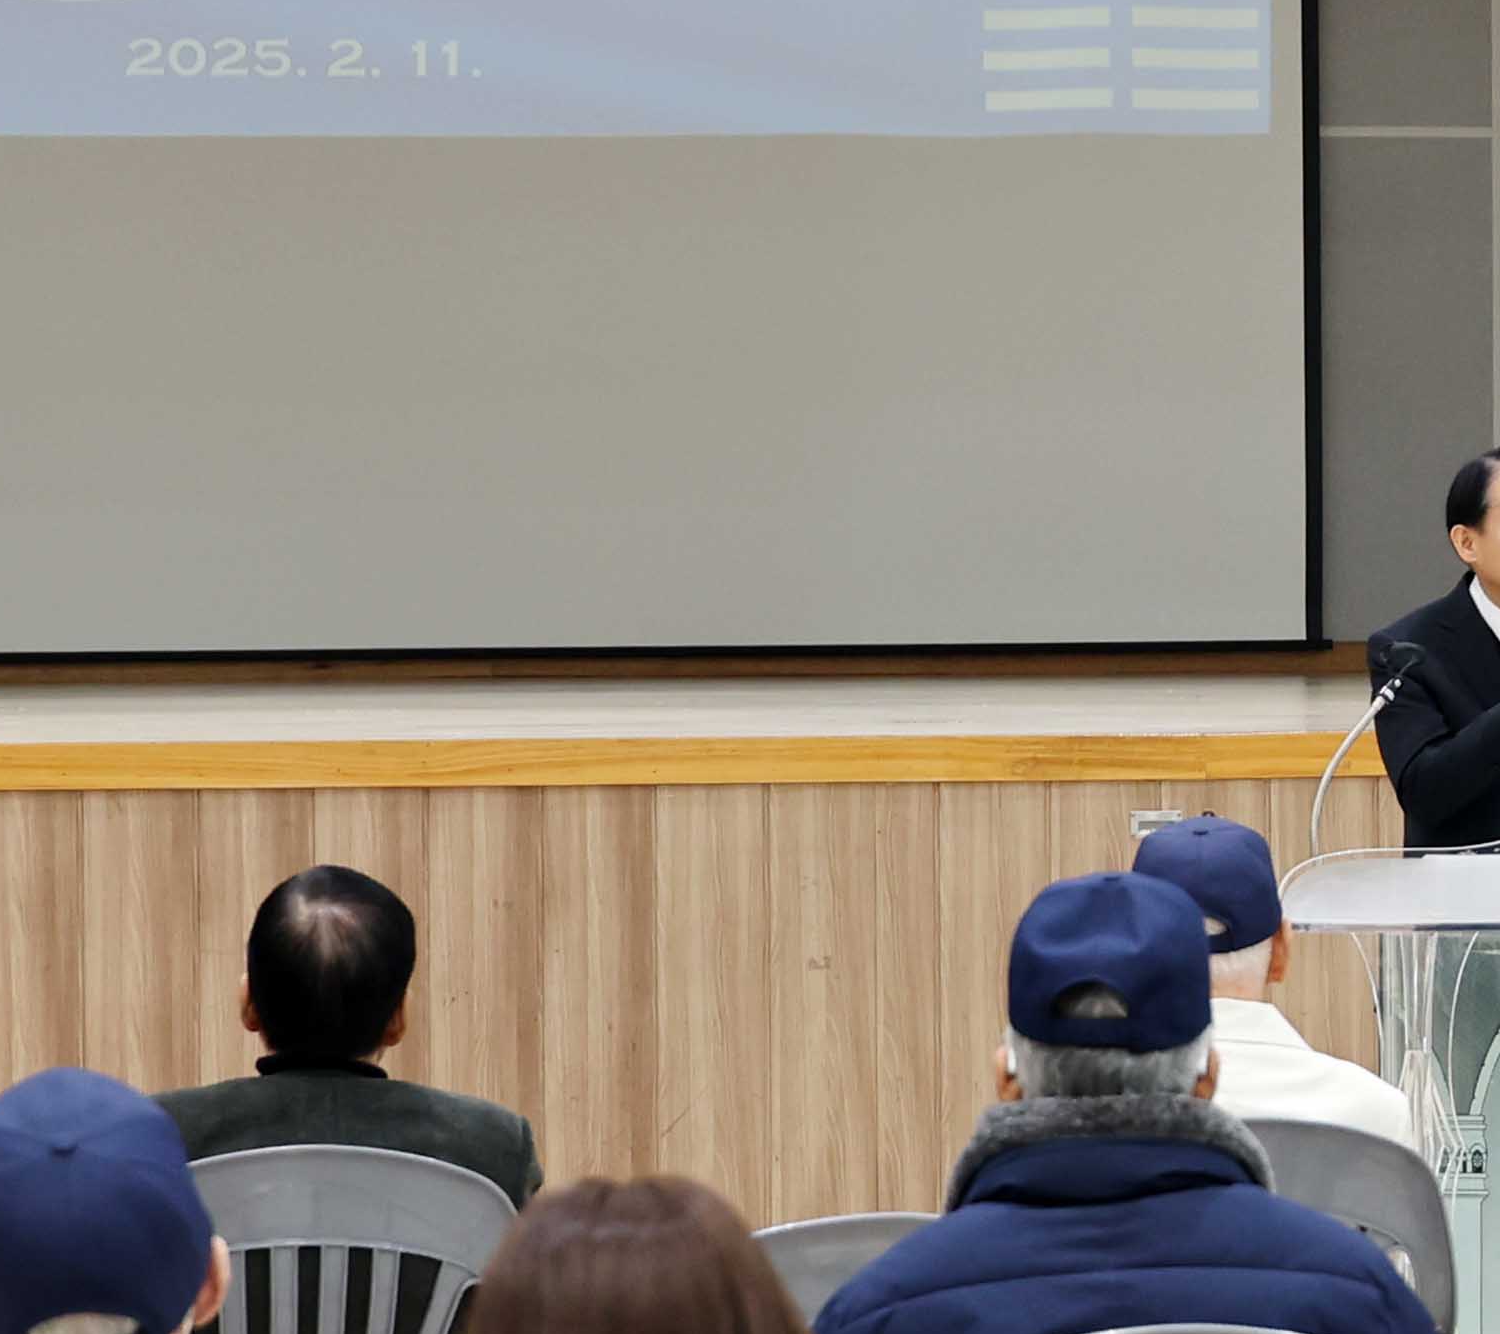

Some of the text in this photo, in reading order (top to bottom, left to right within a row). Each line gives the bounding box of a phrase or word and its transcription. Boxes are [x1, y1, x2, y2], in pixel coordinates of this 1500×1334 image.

[125, 37, 482, 78] 2025. 2. 11.
